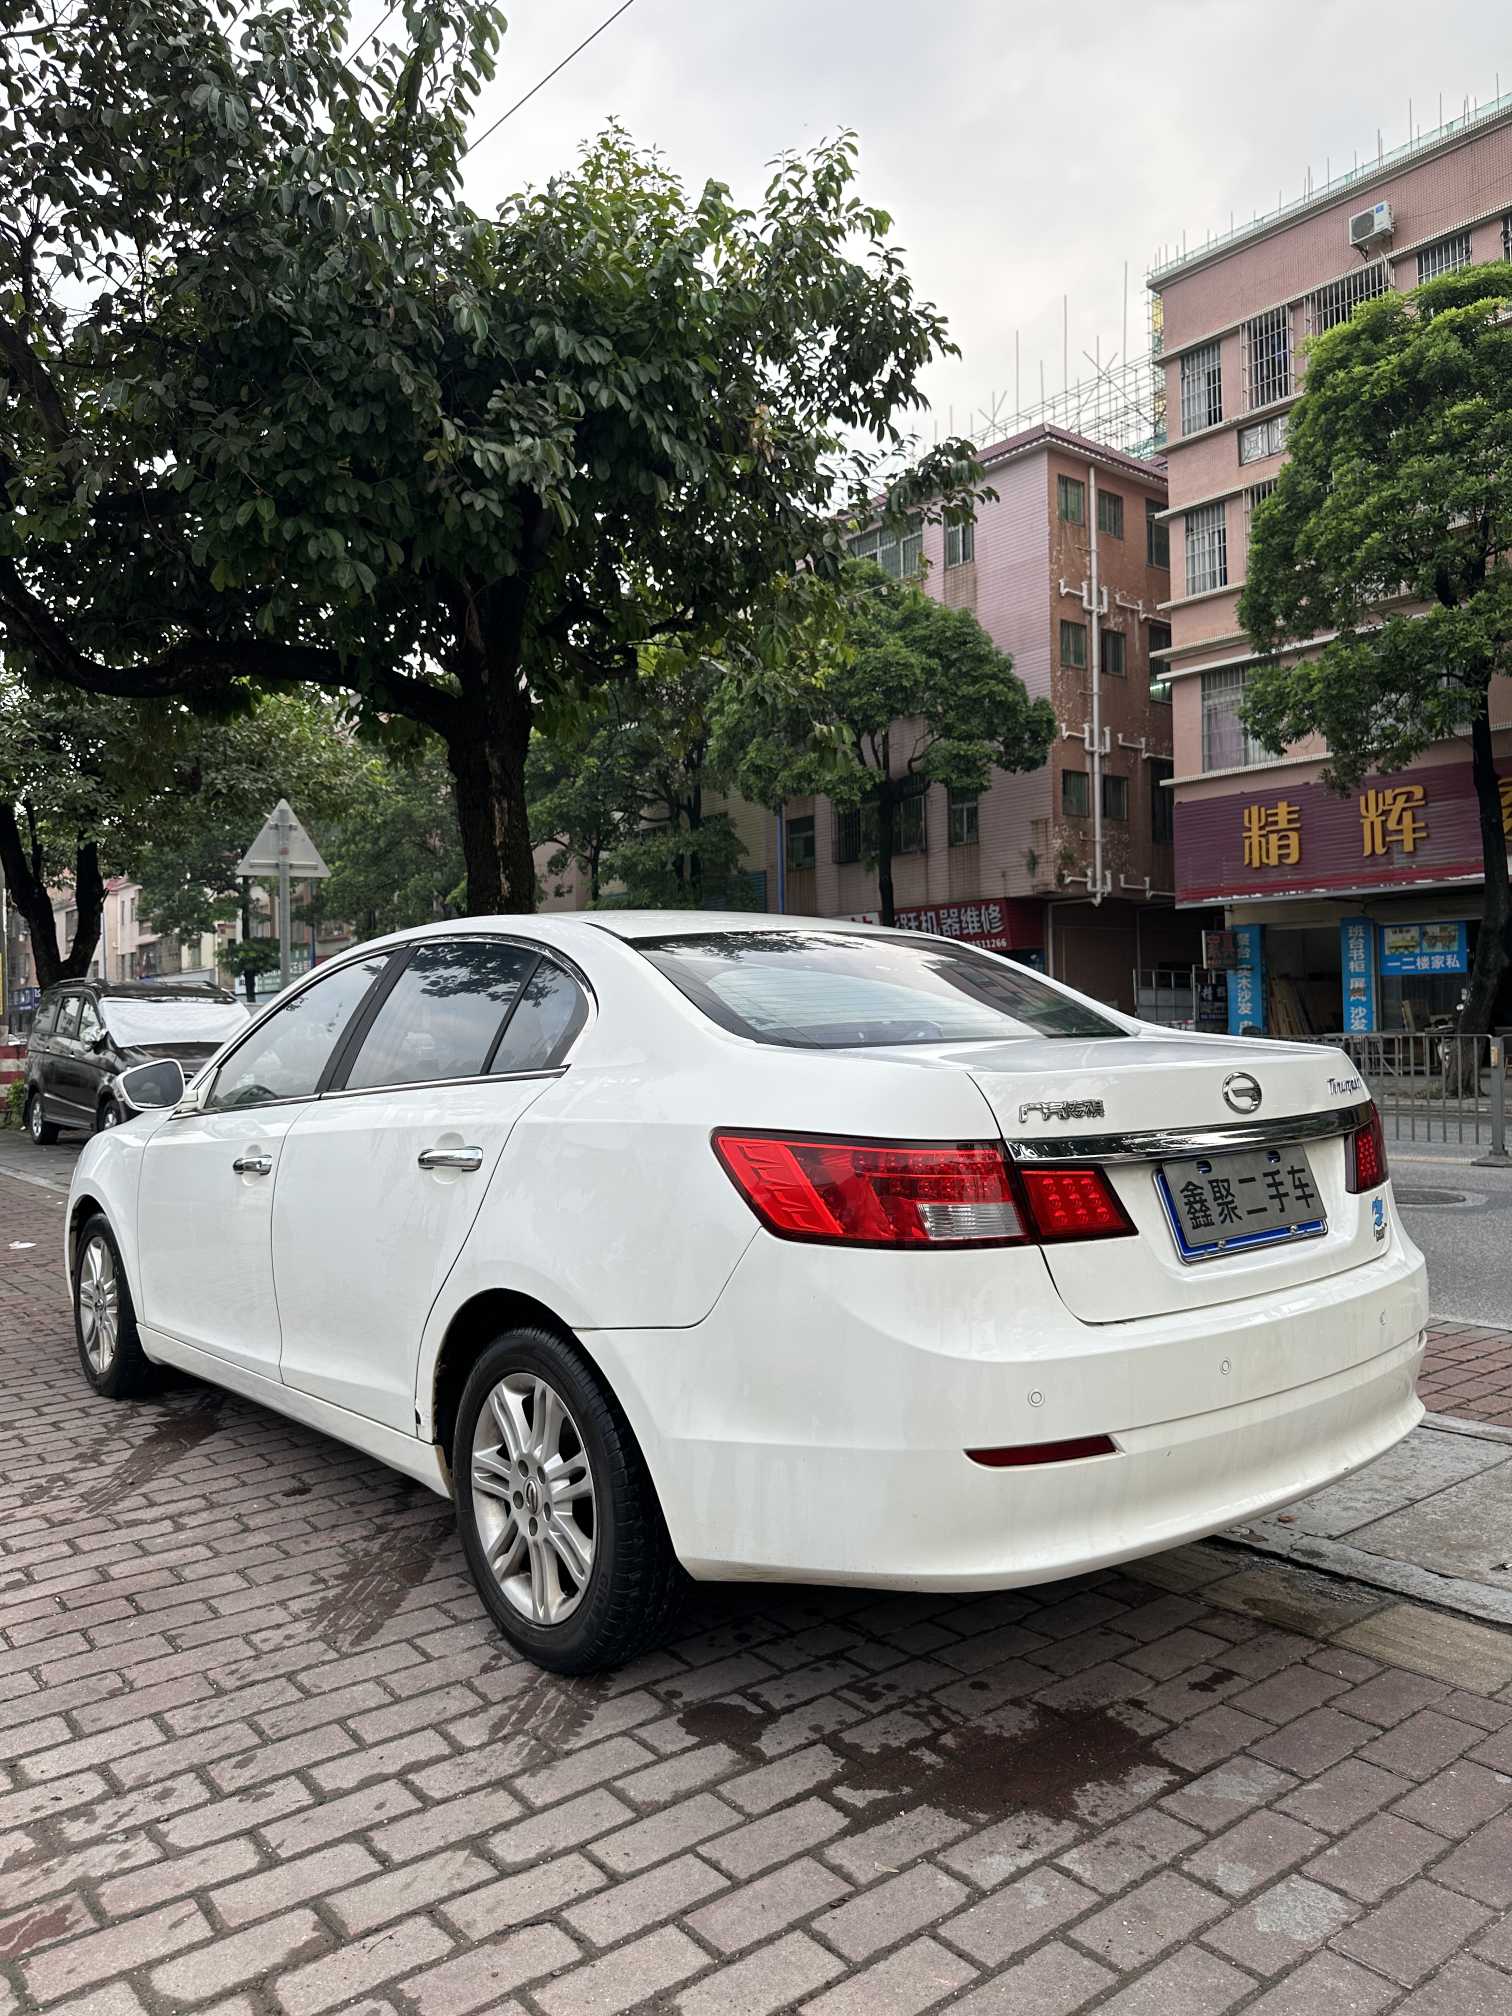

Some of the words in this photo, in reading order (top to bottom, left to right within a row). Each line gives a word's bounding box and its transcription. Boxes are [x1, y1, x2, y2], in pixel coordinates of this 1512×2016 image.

[1180, 1165, 1315, 1230] 鑫聚二手车
